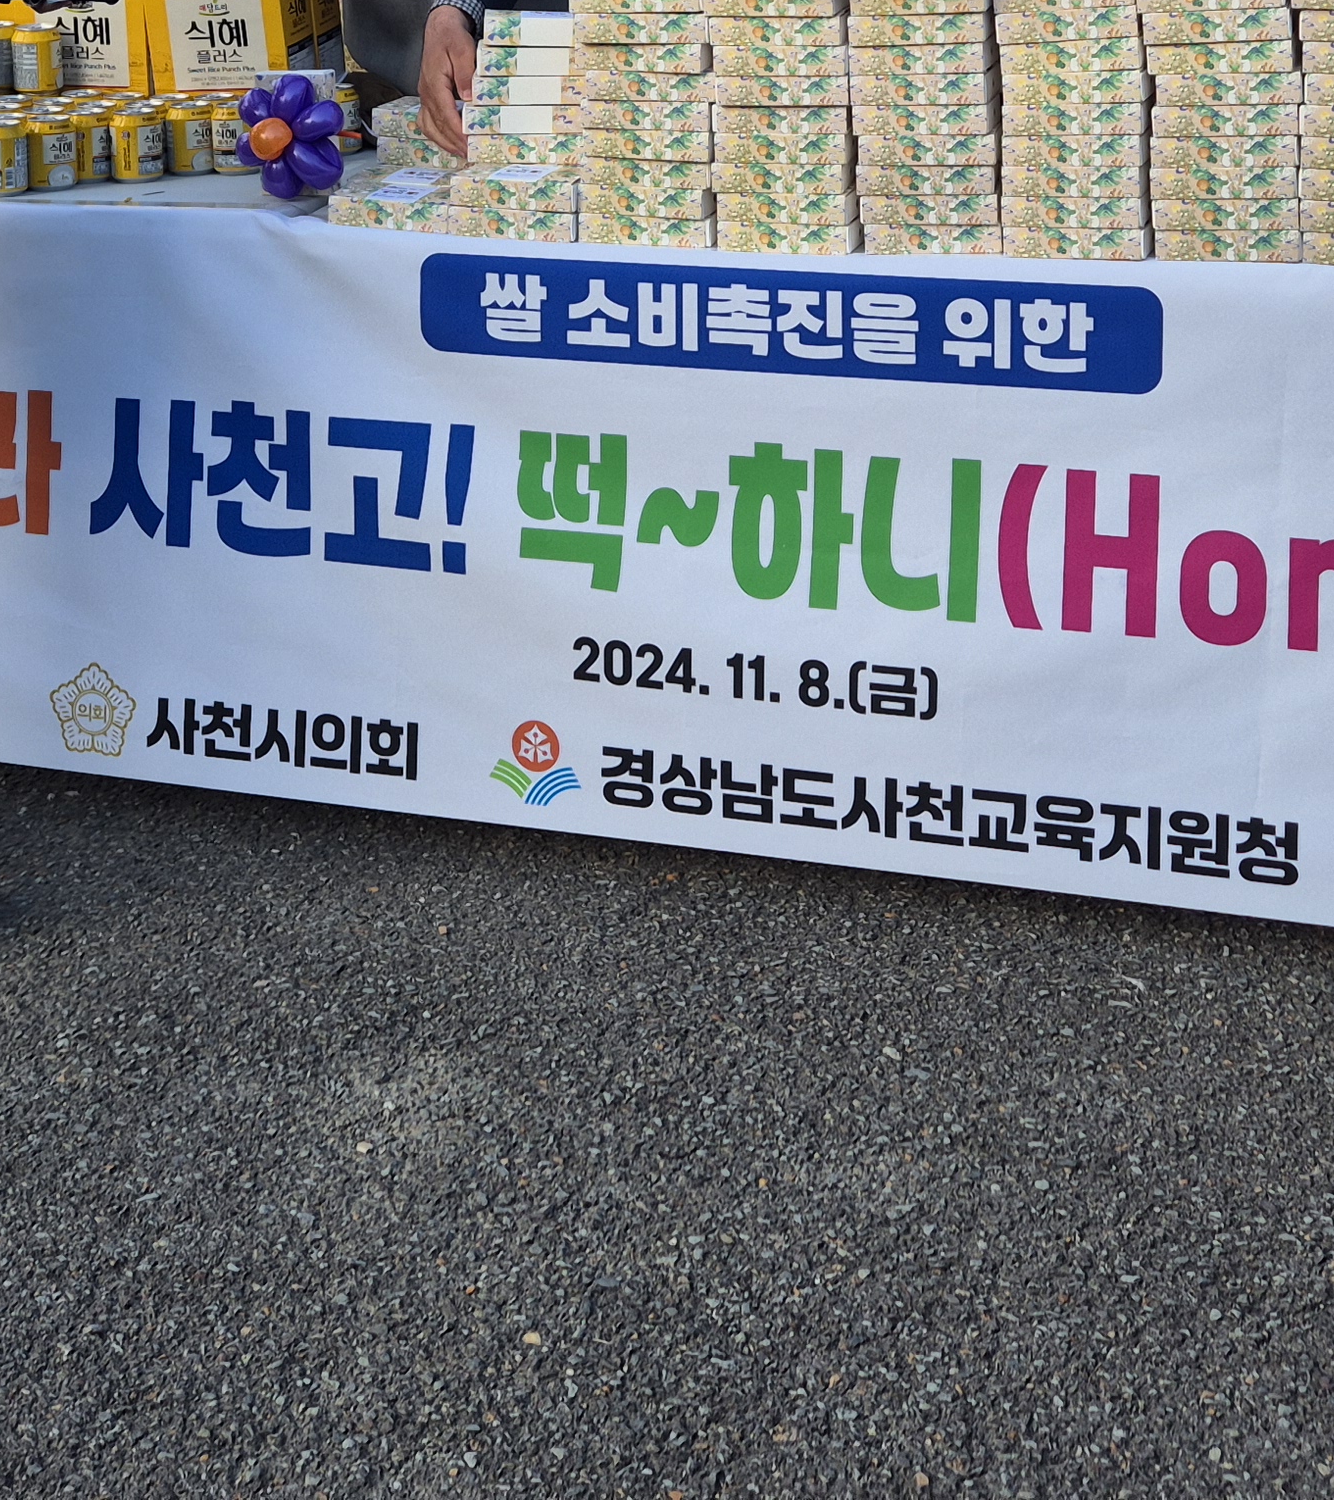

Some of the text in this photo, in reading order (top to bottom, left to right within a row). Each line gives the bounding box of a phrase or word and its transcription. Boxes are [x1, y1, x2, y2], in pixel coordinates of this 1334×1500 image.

[54, 16, 111, 45] 식혜
[184, 18, 249, 48] 식혜
[196, 49, 243, 64] 플러스
[479, 271, 1095, 373] 쌀 소비촉진을 위한
[89, 397, 476, 576] 사천고!
[77, 703, 107, 724] 의회
[572, 636, 940, 721] 2024. 11. 8.(금)
[146, 697, 419, 781] 사천시의회
[599, 745, 1301, 887] 경상남도사천교육지원청
